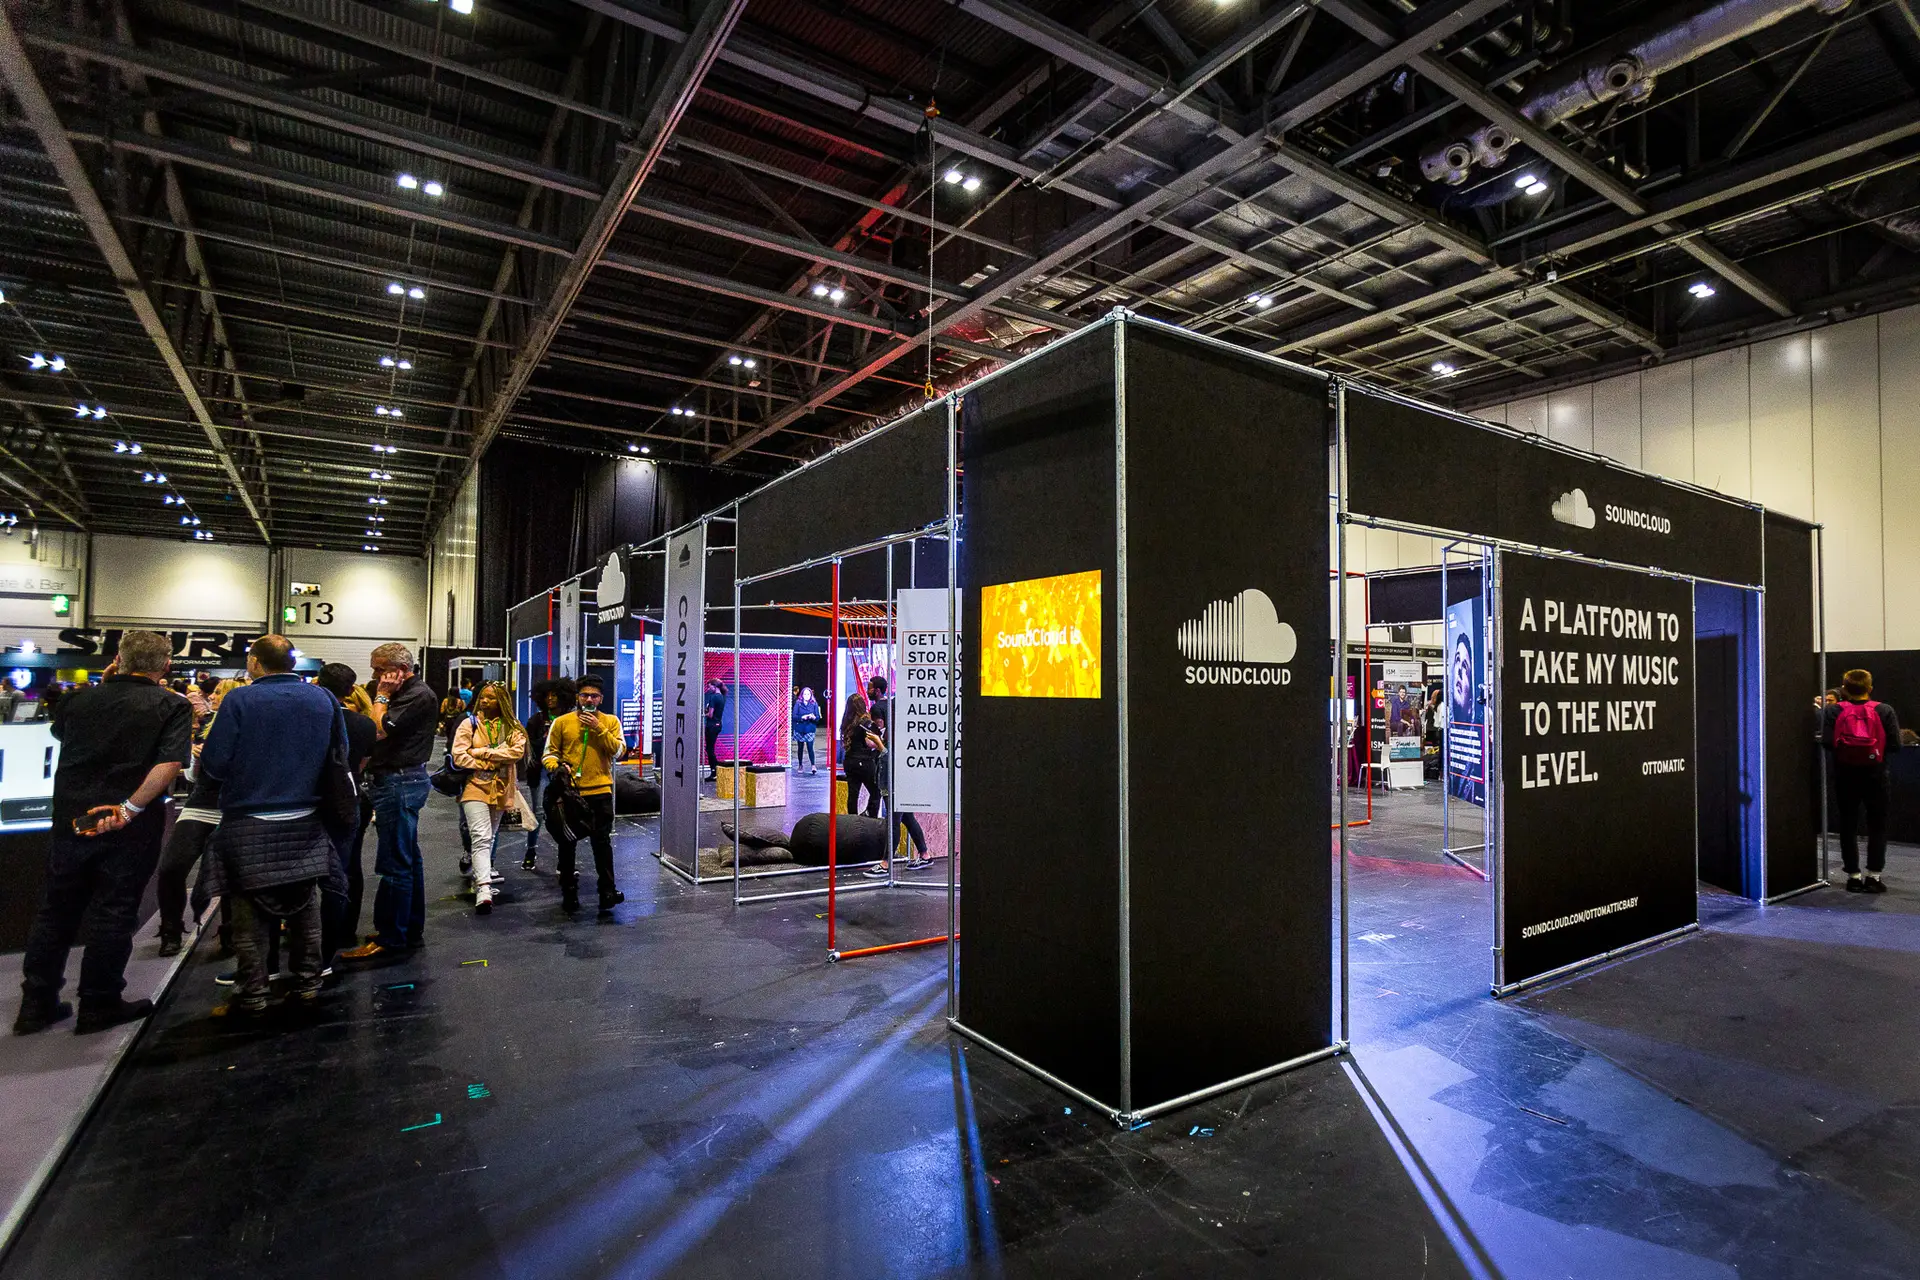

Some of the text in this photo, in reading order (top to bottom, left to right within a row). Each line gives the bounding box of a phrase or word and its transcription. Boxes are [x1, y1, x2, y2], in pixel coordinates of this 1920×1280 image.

[1605, 504, 1671, 534] SOUNDCLOUD
[40, 578, 67, 590] Bar
[300, 601, 334, 625] 13
[1520, 598, 1679, 642] A PLATFORM TO
[908, 634, 937, 646] GET
[998, 626, 1067, 648] SoundCloud
[908, 651, 962, 663] STOR
[1520, 650, 1679, 685] TAKE MY MUSIC
[908, 669, 937, 680] FOR
[1185, 666, 1291, 685] SOUNDCLOUD
[675, 595, 689, 787] CONNECT
[1521, 700, 1656, 736] TO THE NEXT
[907, 739, 939, 750] AND
[1522, 751, 1599, 789] LEVEL.
[1642, 758, 1686, 776] OTTOMATIC
